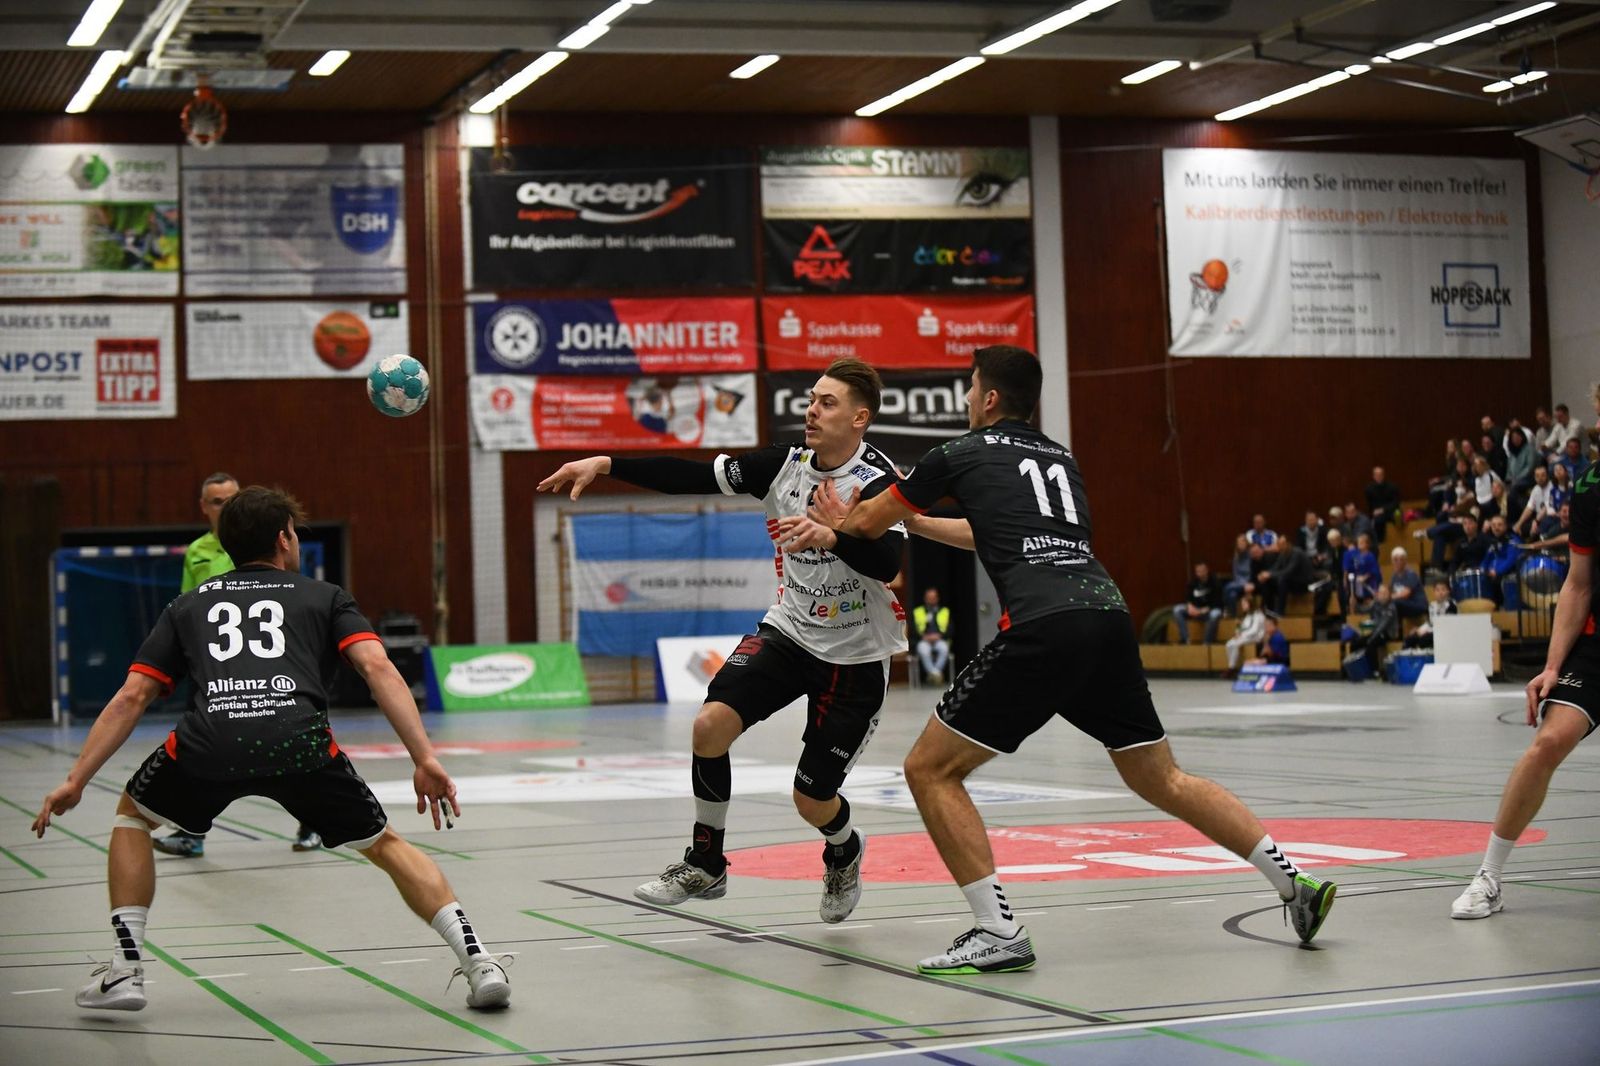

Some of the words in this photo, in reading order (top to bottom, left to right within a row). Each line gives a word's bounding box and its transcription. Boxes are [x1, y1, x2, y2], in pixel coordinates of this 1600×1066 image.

[872, 150, 962, 176] STAMM
[1184, 172, 1214, 188] Mit
[1218, 173, 1247, 189] uns
[1252, 172, 1309, 190] landen
[1313, 173, 1337, 191] Sie
[1342, 174, 1394, 193] immer
[1398, 175, 1444, 194] einen
[1449, 177, 1507, 195] Treffer!
[516, 178, 670, 211] concept
[342, 212, 390, 232] DSH
[1185, 203, 1385, 226] Kalibrierdienstleistungen
[1397, 207, 1509, 226] Elektrotechnik
[489, 234, 510, 249] Ihr
[606, 234, 626, 248] bei
[793, 261, 850, 279] PEAK
[1431, 286, 1512, 306] HOPPESACK
[59, 315, 111, 328] TEAM
[808, 321, 882, 339] Sparkasse
[945, 320, 1019, 338] Sparkasse
[557, 322, 739, 350] JOHANNITER
[101, 353, 156, 372] EXTRA
[102, 375, 157, 400] TIPP
[1018, 457, 1079, 525] 11
[226, 583, 281, 591] Rhein-Neckar
[809, 589, 867, 619] Leben!
[207, 600, 286, 662] 33
[207, 677, 267, 696] Allianz
[207, 701, 248, 713] Christian
[228, 709, 276, 719] Dudenhofen
[830, 746, 850, 759] JAKO
[951, 944, 1001, 964] SALMING
